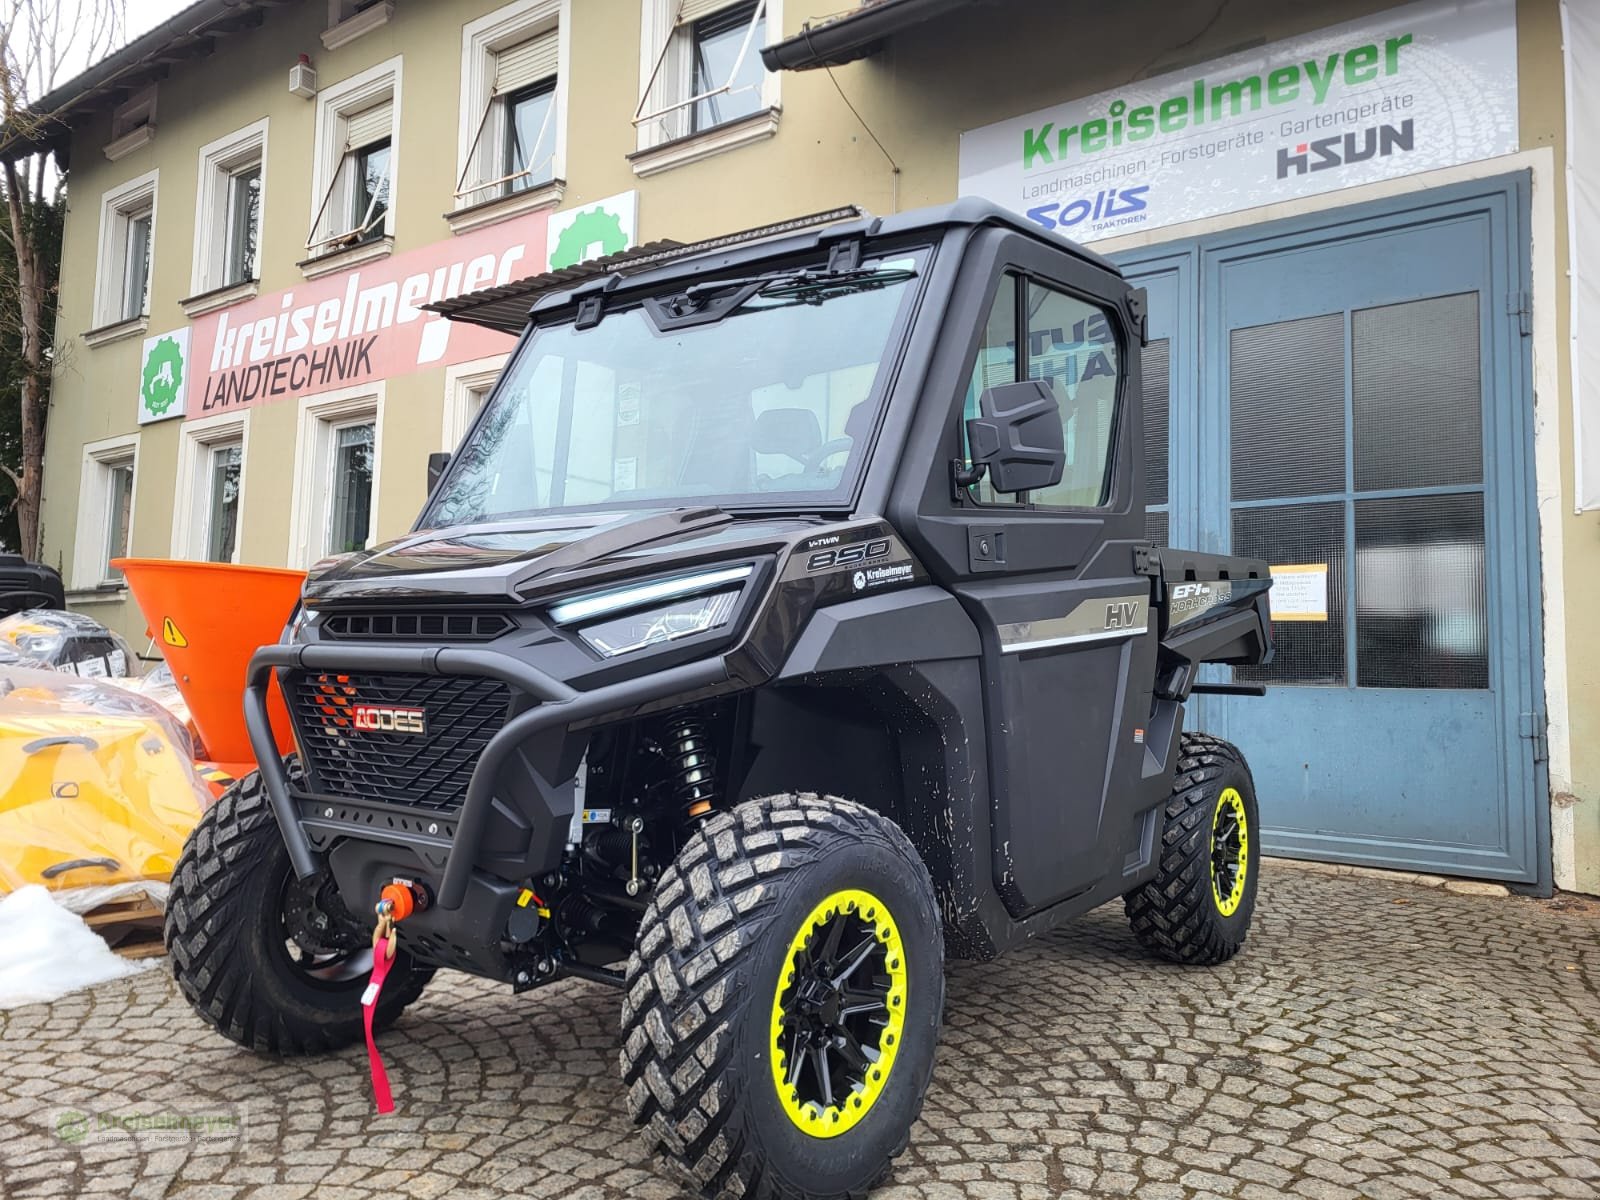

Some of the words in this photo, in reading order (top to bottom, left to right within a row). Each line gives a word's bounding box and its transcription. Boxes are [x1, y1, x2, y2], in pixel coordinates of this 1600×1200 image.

[1022, 32, 1414, 169] Kreiselmeyer
[1022, 159, 1147, 200] Landmaschinen
[1161, 127, 1264, 166] Forstgeräte
[1280, 93, 1414, 138] Gartengeräte
[1092, 214, 1147, 232] TRAKTOREN
[210, 244, 526, 373] kreiselmeyer
[202, 335, 380, 411] LANDTECHNIK
[806, 536, 892, 572] 850
[809, 536, 840, 548] V-TWIN
[1104, 601, 1138, 629] HV
[356, 708, 423, 732] AODES
